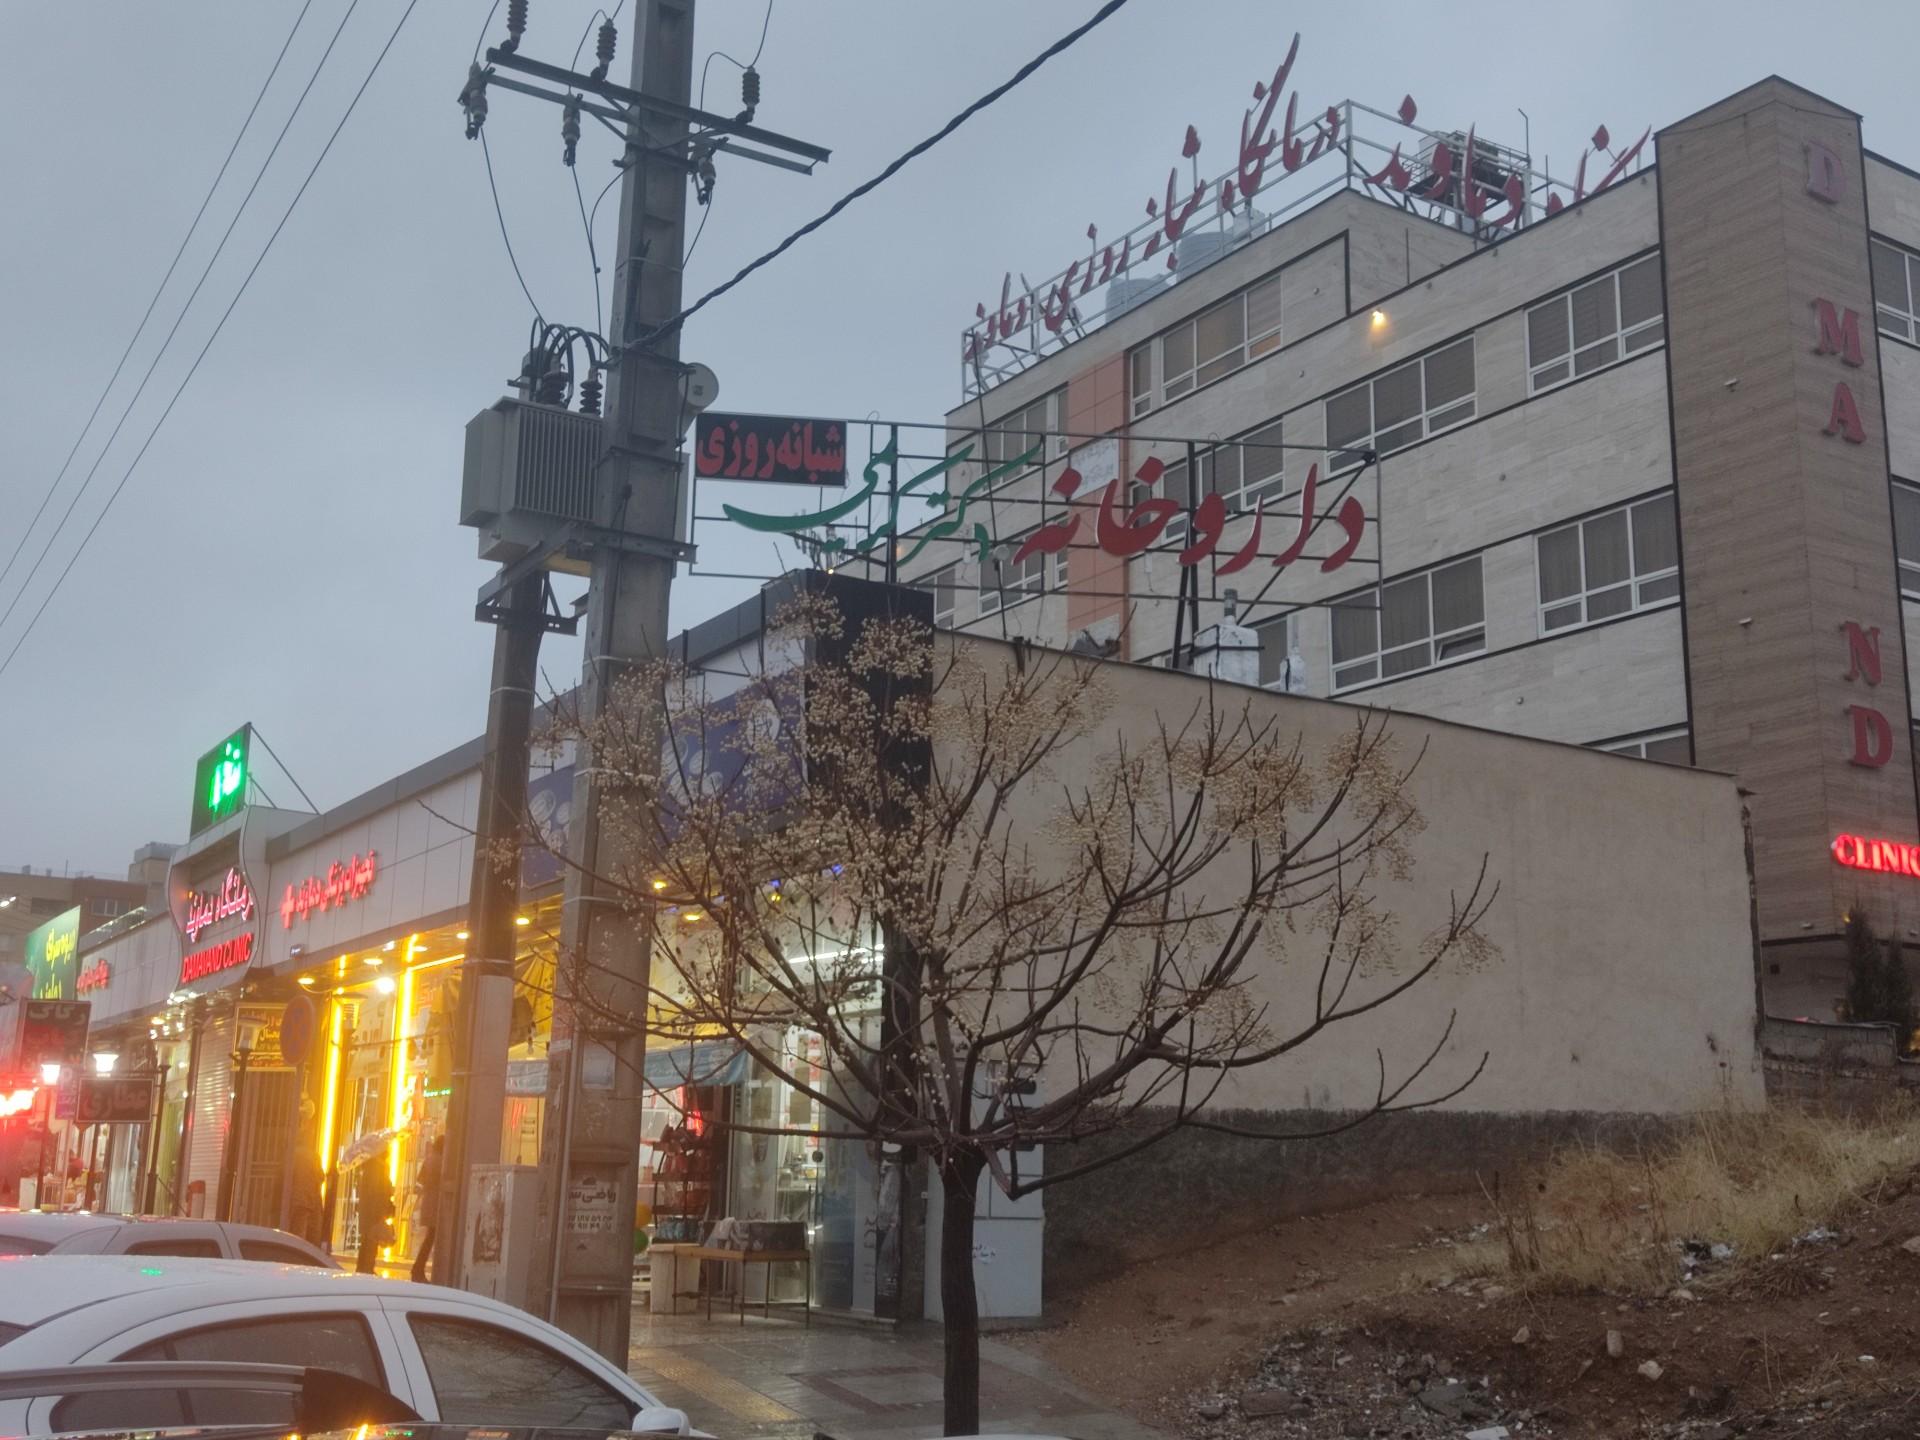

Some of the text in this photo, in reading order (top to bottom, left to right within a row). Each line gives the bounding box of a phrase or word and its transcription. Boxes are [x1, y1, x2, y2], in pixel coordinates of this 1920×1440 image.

[1221, 31, 1340, 210] درمانگاه
[964, 272, 1027, 361] دماوند
[1011, 456, 1366, 576] داروخانه
[223, 933, 252, 968] CLINIC
